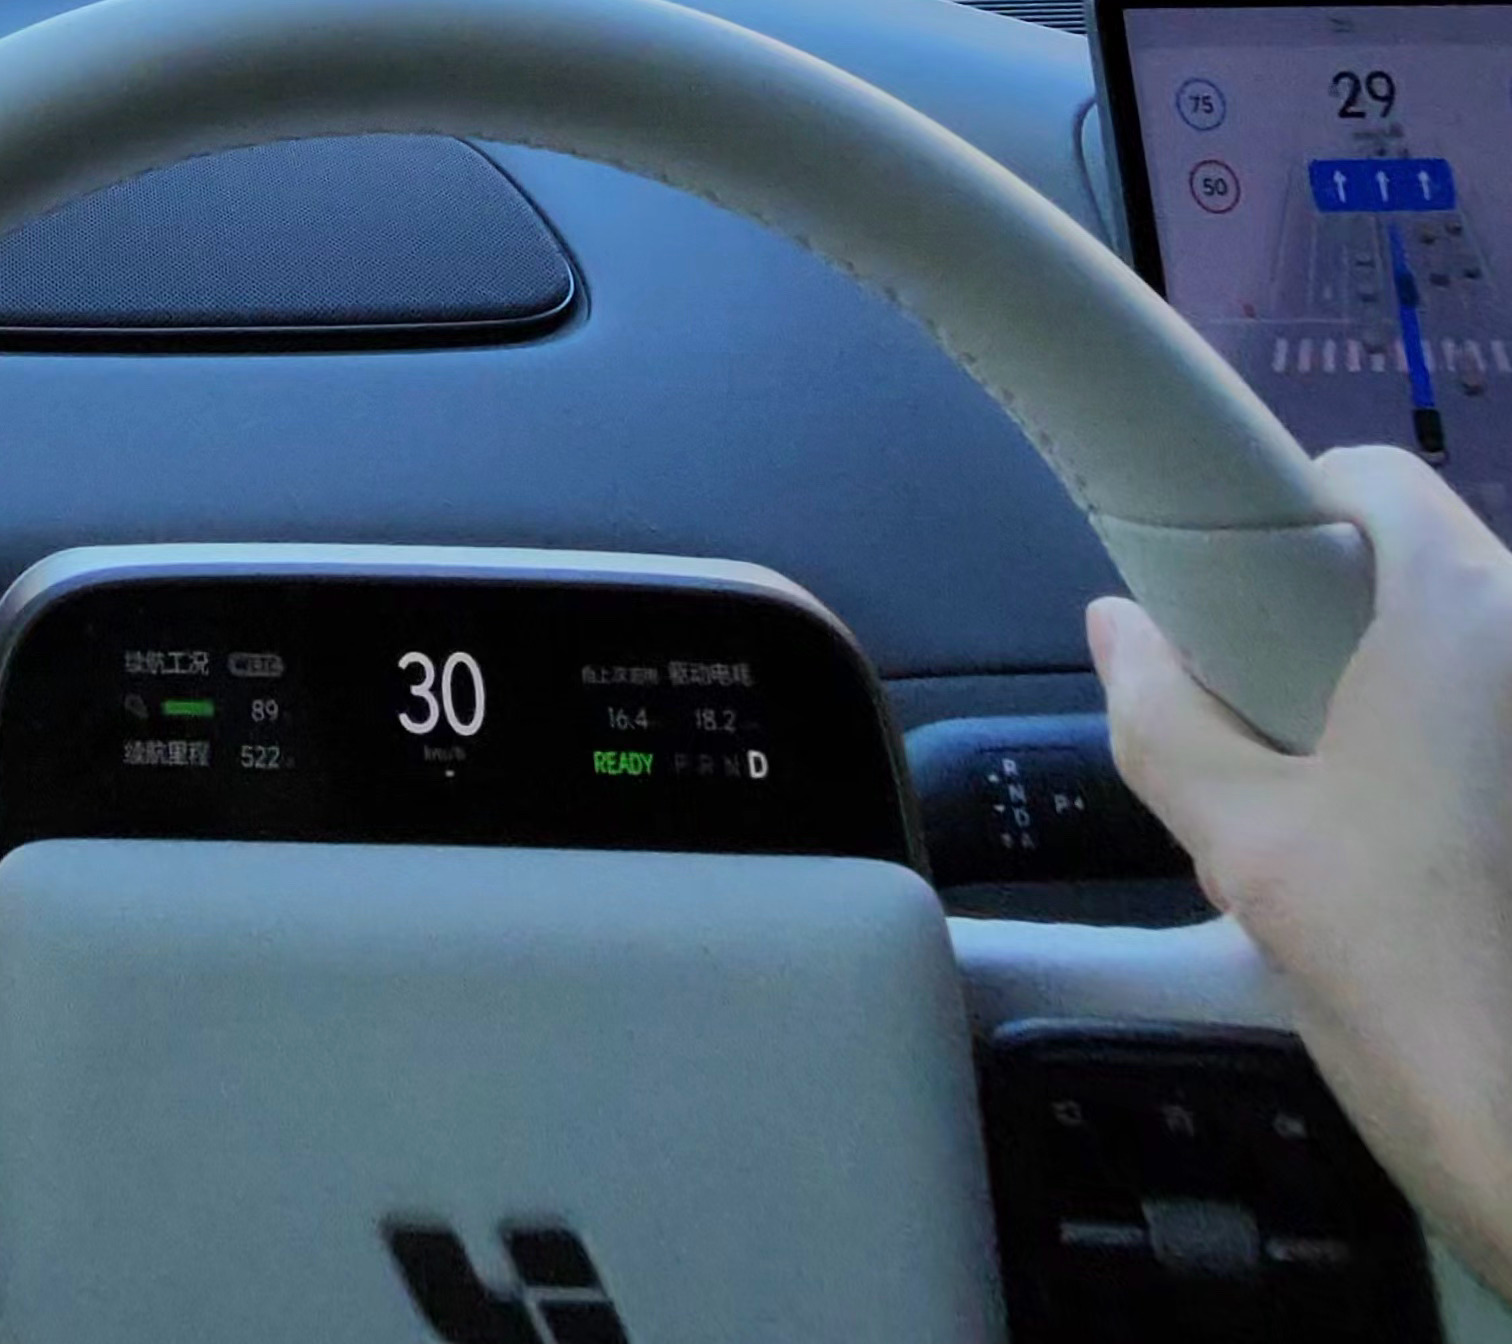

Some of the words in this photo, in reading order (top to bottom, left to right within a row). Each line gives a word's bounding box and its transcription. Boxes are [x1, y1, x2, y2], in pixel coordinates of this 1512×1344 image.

[1190, 95, 1214, 114] 75
[1332, 70, 1396, 118] 29
[1203, 178, 1229, 197] 50
[398, 651, 485, 736] 30
[251, 699, 279, 722] 89
[607, 706, 648, 730] 16.4
[695, 708, 737, 733] 18.2
[241, 745, 281, 769] 522
[593, 750, 654, 776] READY
[747, 749, 769, 779] D
[1002, 758, 1018, 776] R
[1008, 784, 1027, 804] N
[1054, 794, 1069, 814] P
[1012, 807, 1031, 828] D
